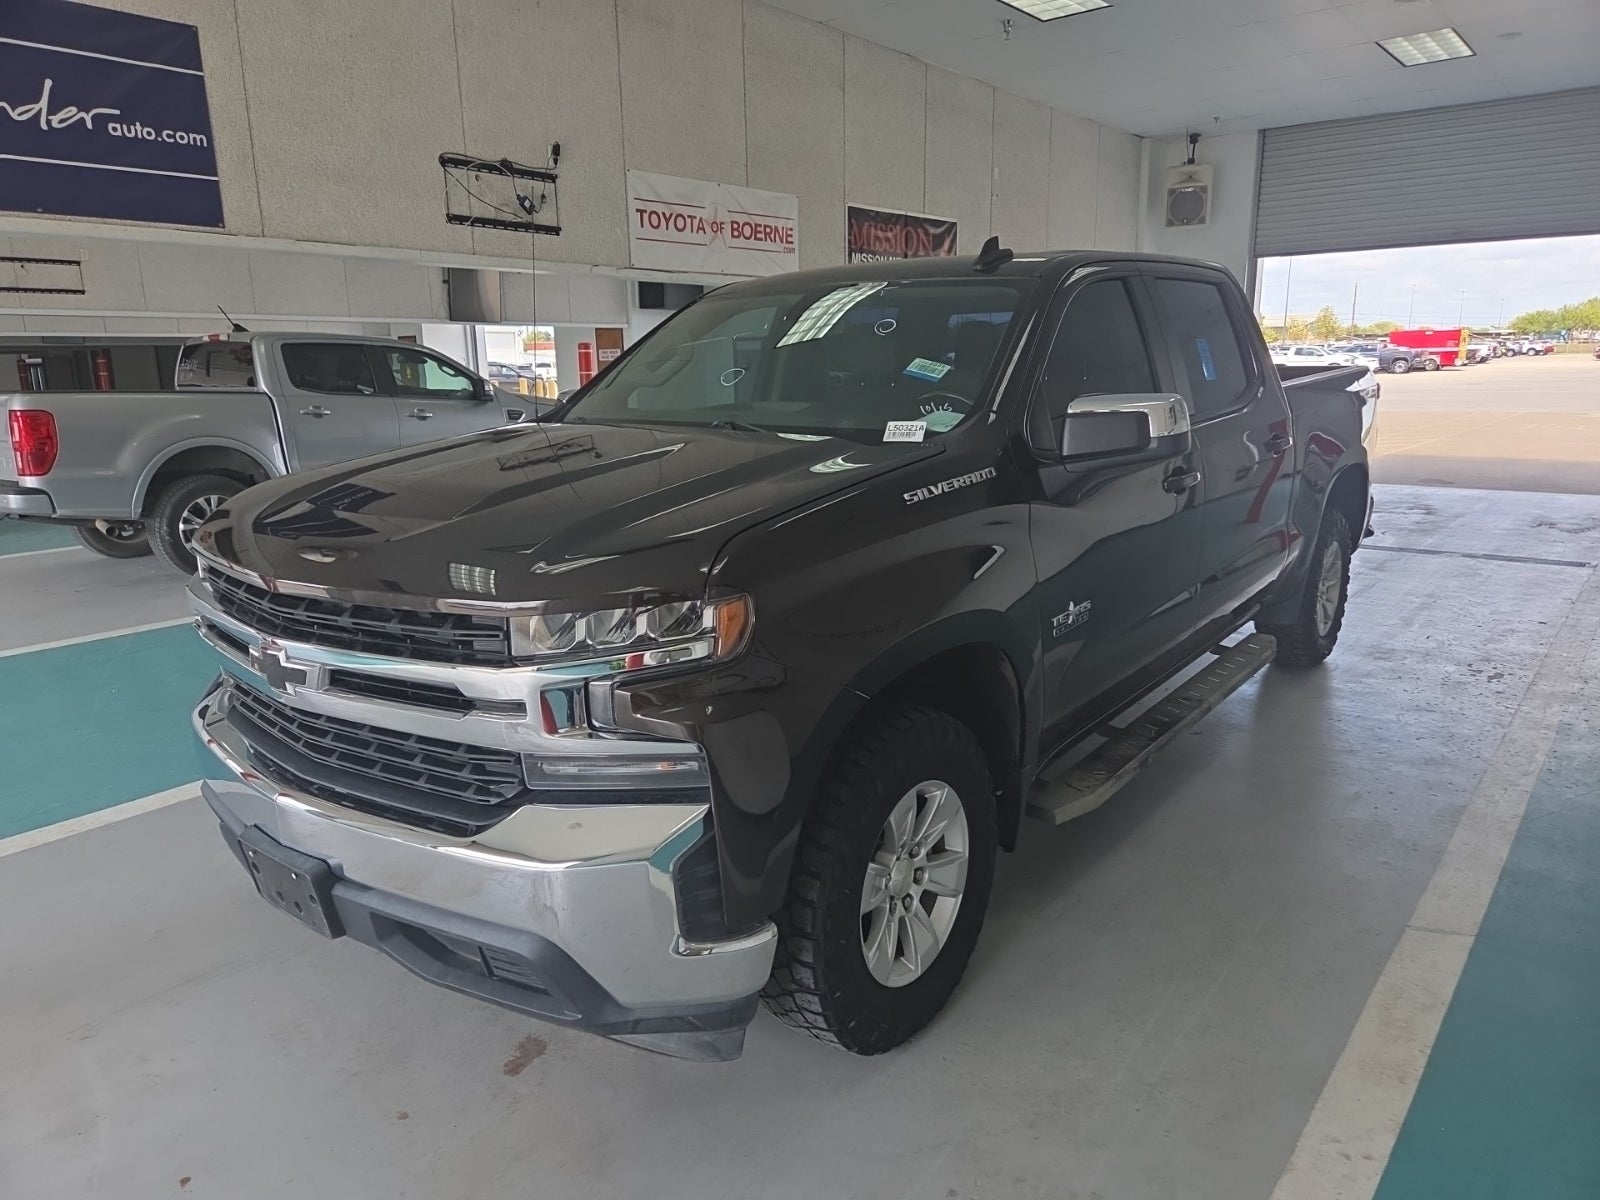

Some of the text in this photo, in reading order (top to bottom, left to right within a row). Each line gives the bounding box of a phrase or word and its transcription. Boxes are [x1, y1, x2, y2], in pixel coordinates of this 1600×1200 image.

[108, 121, 208, 147] auto.com
[635, 204, 794, 244] TOYOTA OF BOERNE
[850, 219, 933, 257] MISSION
[887, 424, 925, 432] L50321A
[903, 466, 996, 505] SILVERADO
